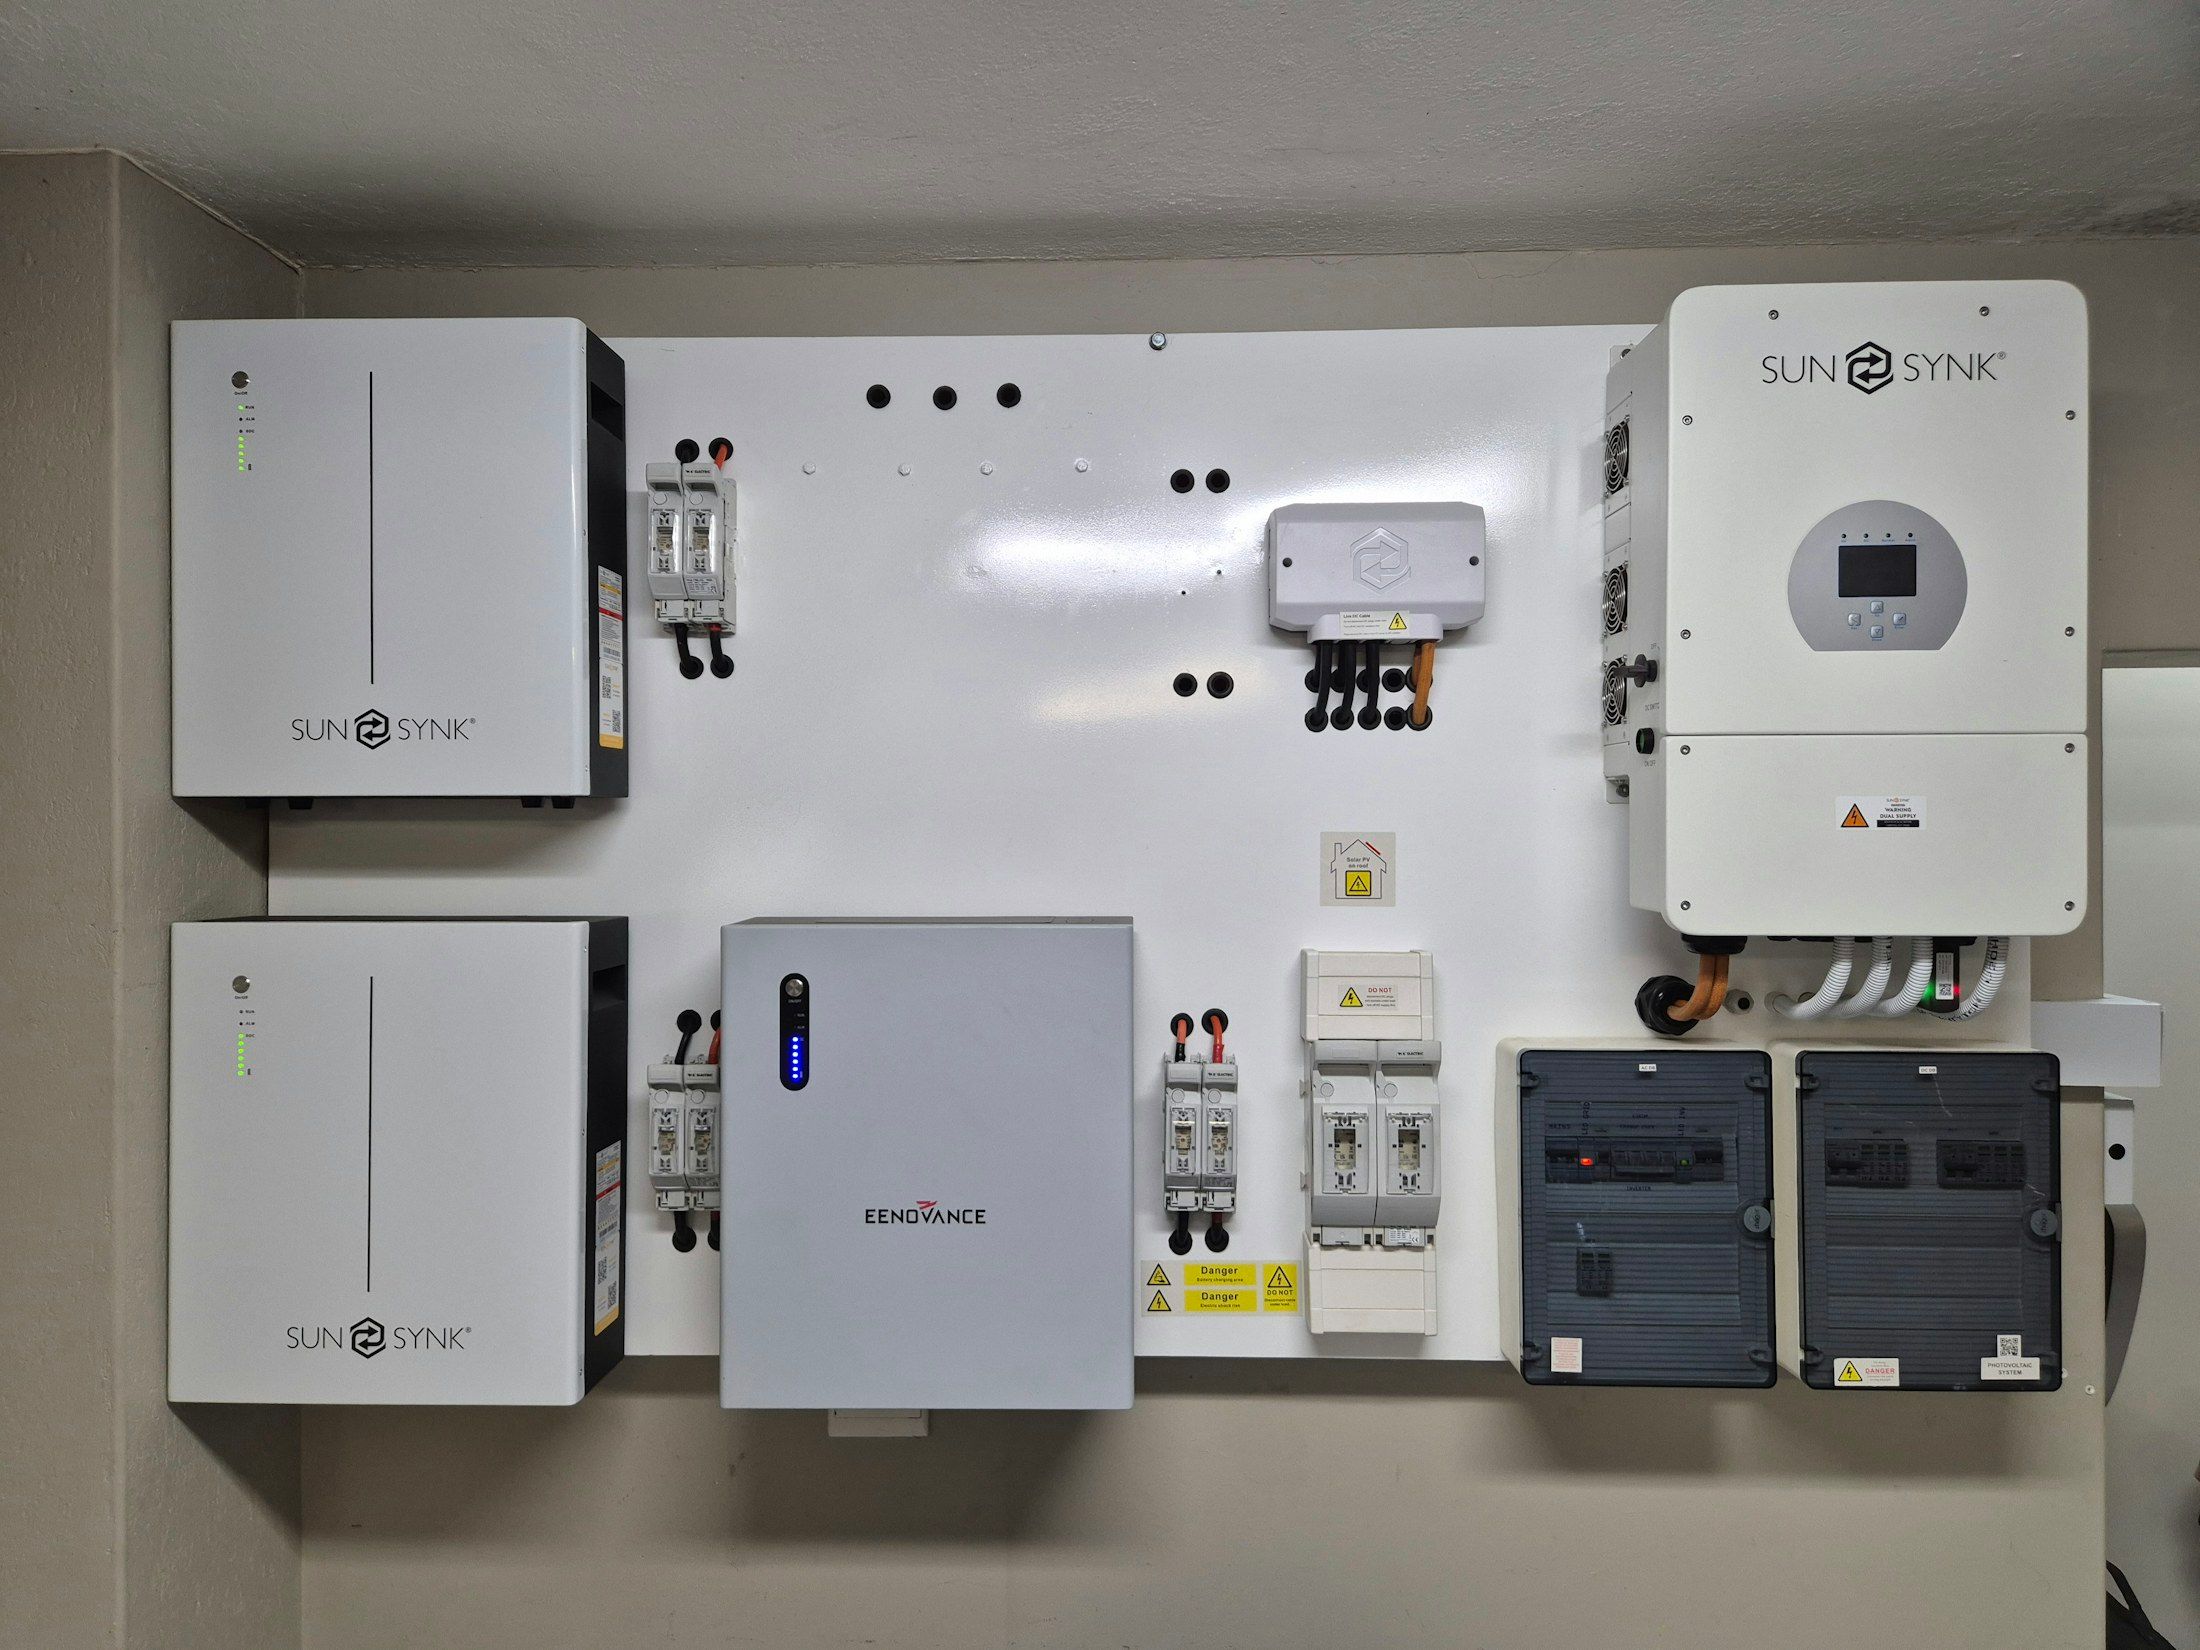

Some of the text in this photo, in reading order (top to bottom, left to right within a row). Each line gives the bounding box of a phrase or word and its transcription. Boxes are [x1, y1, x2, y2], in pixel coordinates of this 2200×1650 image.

[1762, 354, 1836, 383] SUN
[291, 718, 347, 741] SUN
[865, 1207, 986, 1224] EENOVANCE
[1201, 1266, 1239, 1277] Danger
[1201, 1292, 1239, 1302] Danger
[286, 1326, 343, 1349] SUN
[1865, 1367, 1896, 1375] DANGER
